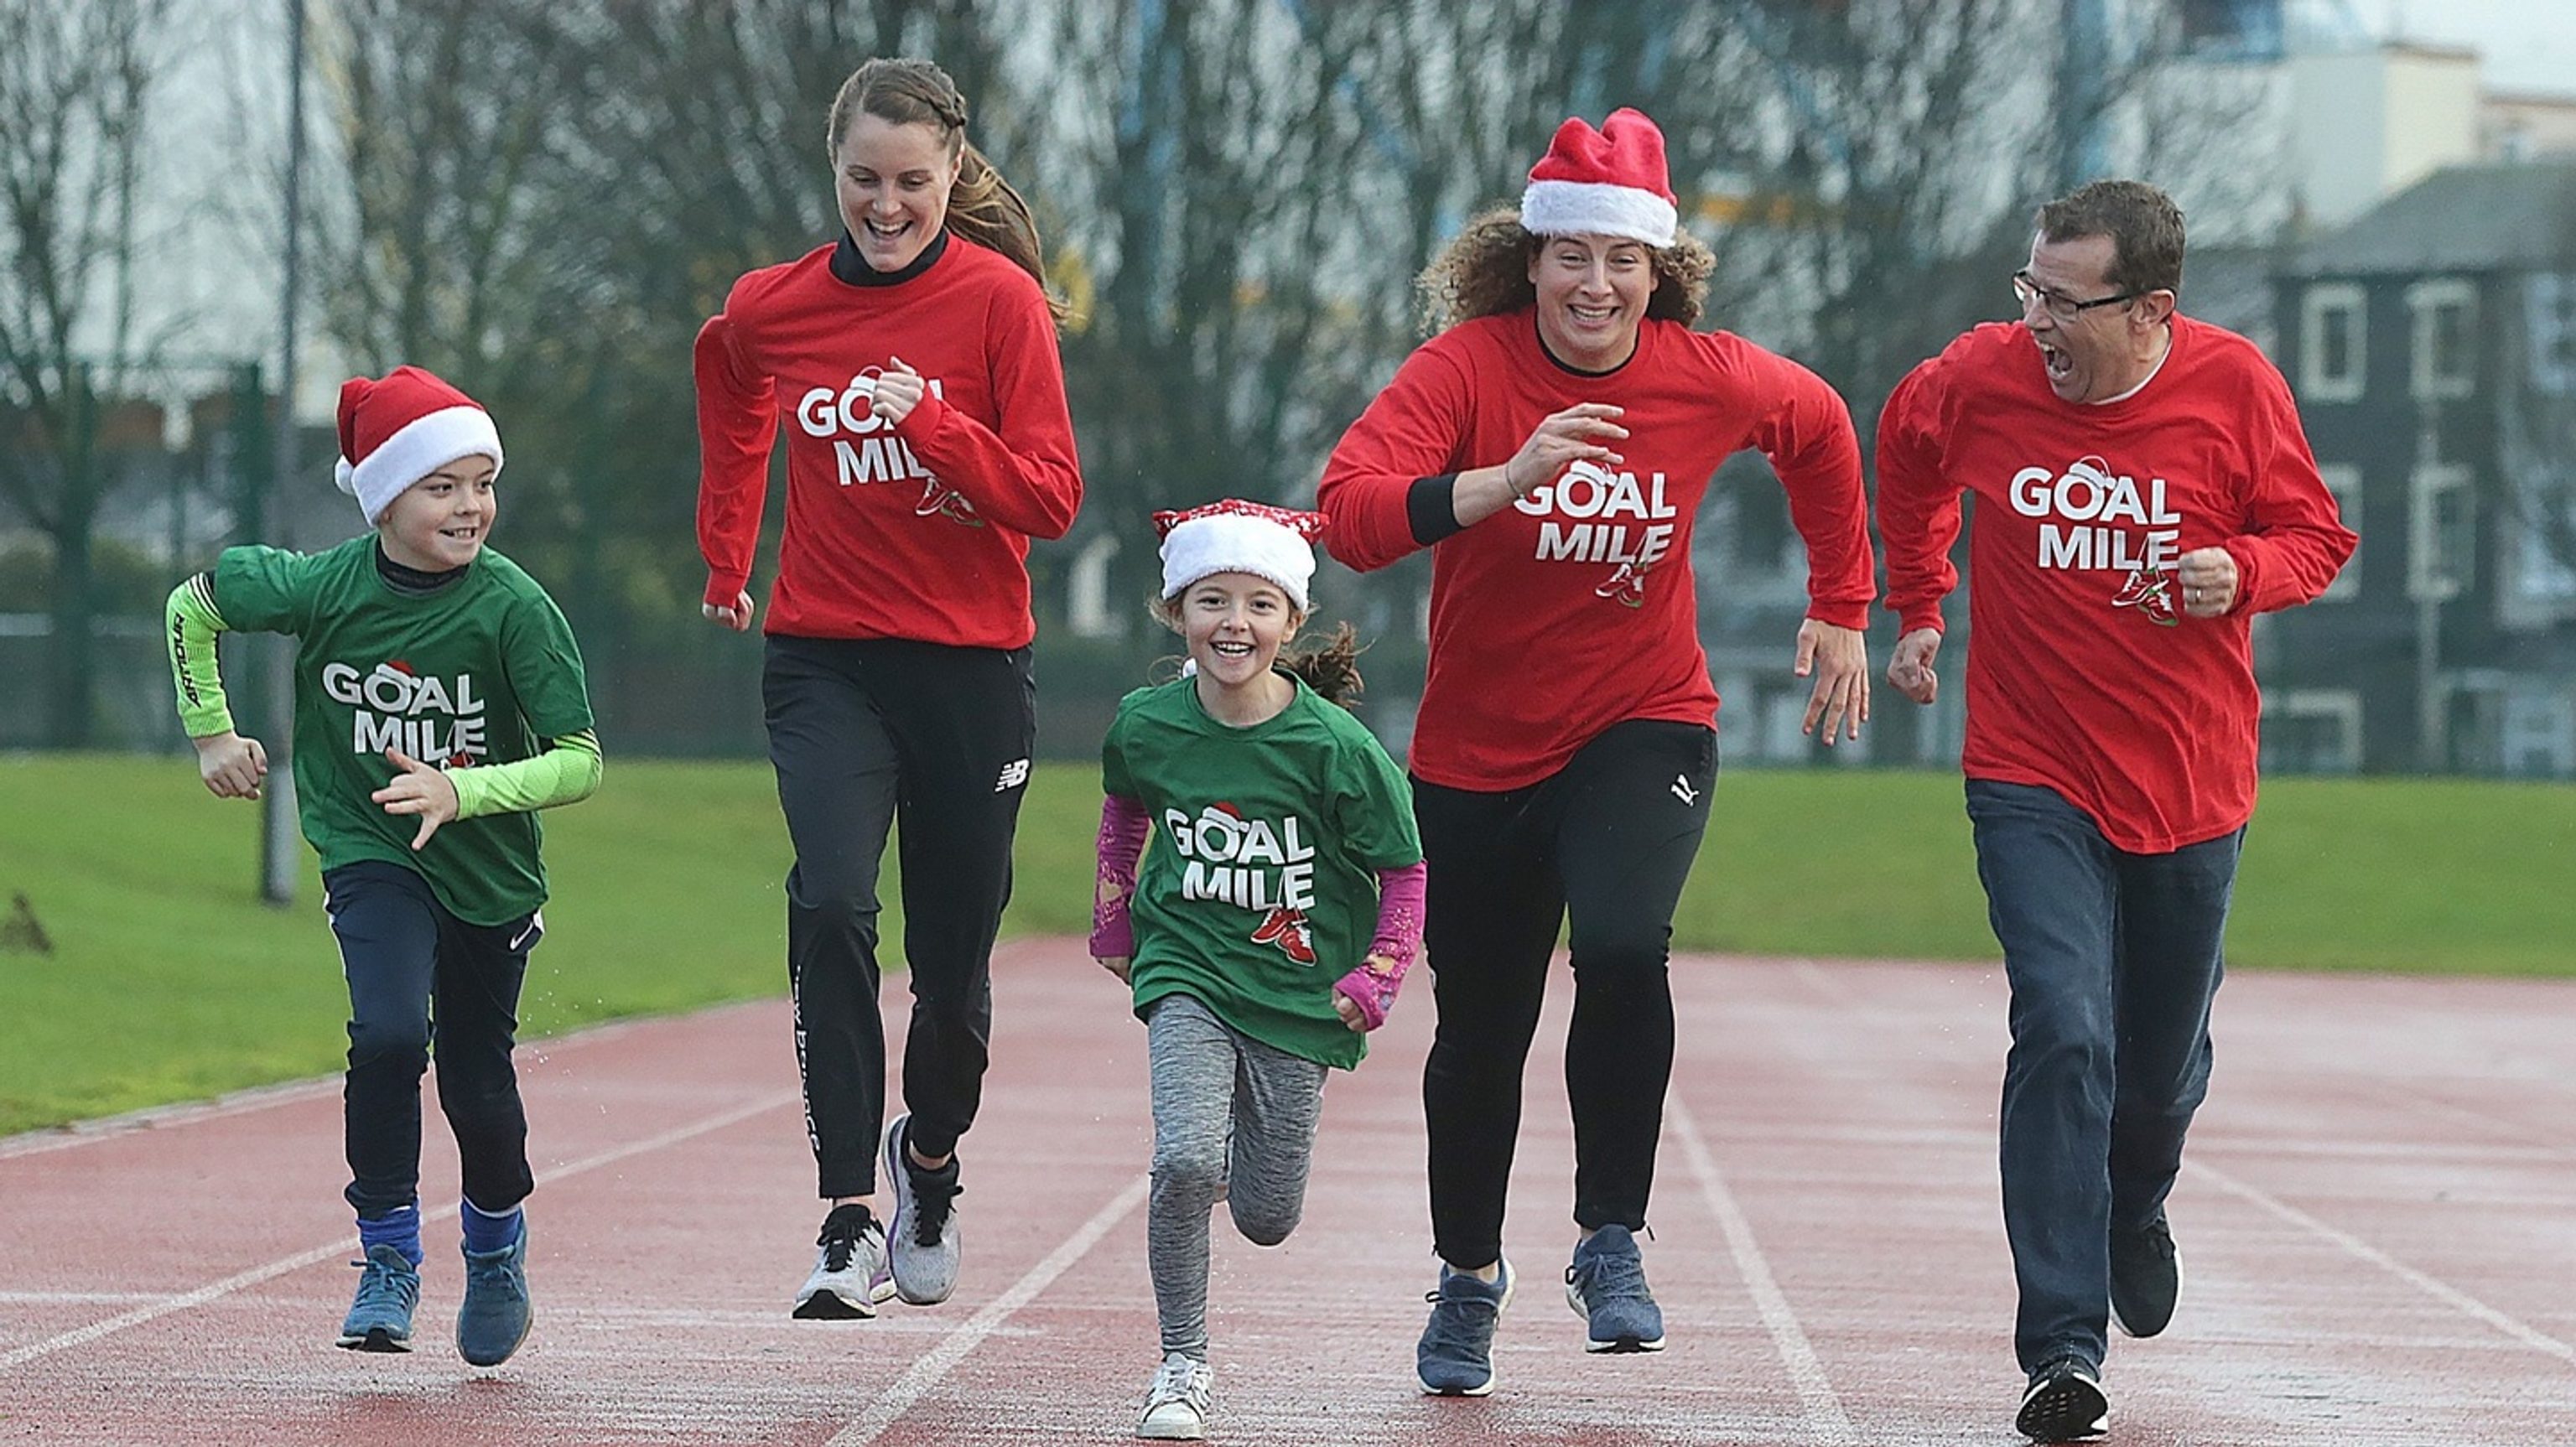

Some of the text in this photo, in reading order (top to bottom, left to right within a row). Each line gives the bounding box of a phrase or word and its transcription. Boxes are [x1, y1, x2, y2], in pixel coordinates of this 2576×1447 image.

[797, 379, 943, 437] GO
[834, 436, 935, 486] MIL
[2010, 467, 2181, 526] GOAL
[1535, 522, 1674, 563] MILE
[2038, 524, 2179, 571] MILE
[323, 662, 485, 716] GOAL
[354, 709, 487, 762] MILE
[1166, 808, 1316, 865] GOAL
[1182, 861, 1316, 910] MILE
